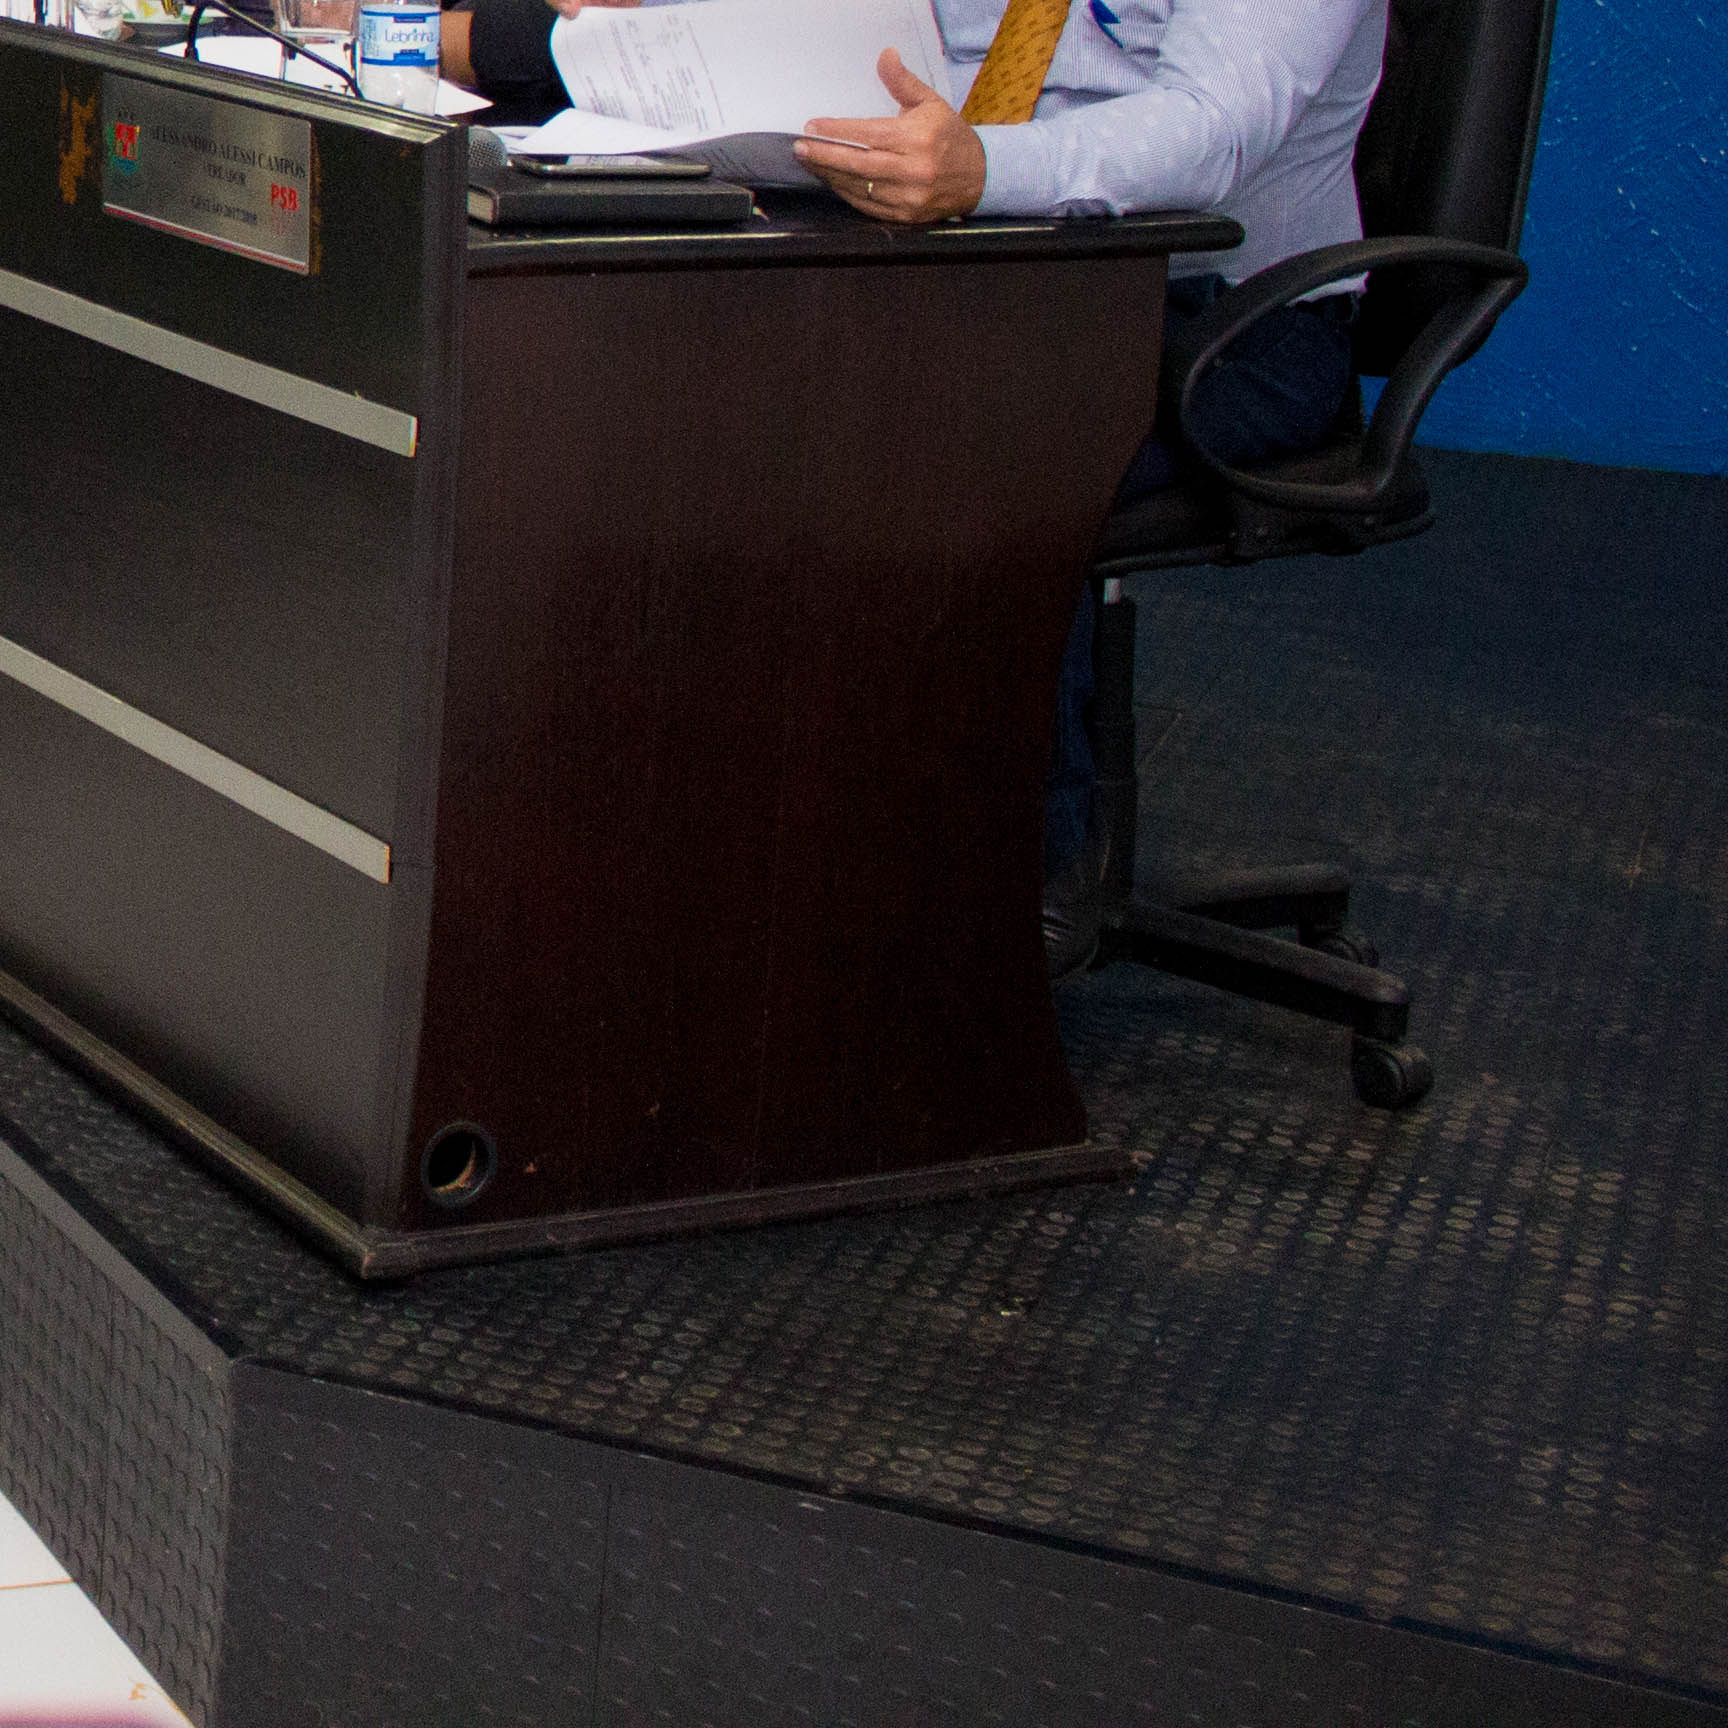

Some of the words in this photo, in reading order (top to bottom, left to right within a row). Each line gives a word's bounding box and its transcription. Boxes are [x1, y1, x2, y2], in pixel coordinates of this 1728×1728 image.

[220, 142, 256, 166] ALESSI
[258, 153, 306, 178] CAMPOS
[270, 183, 299, 212] PSB
